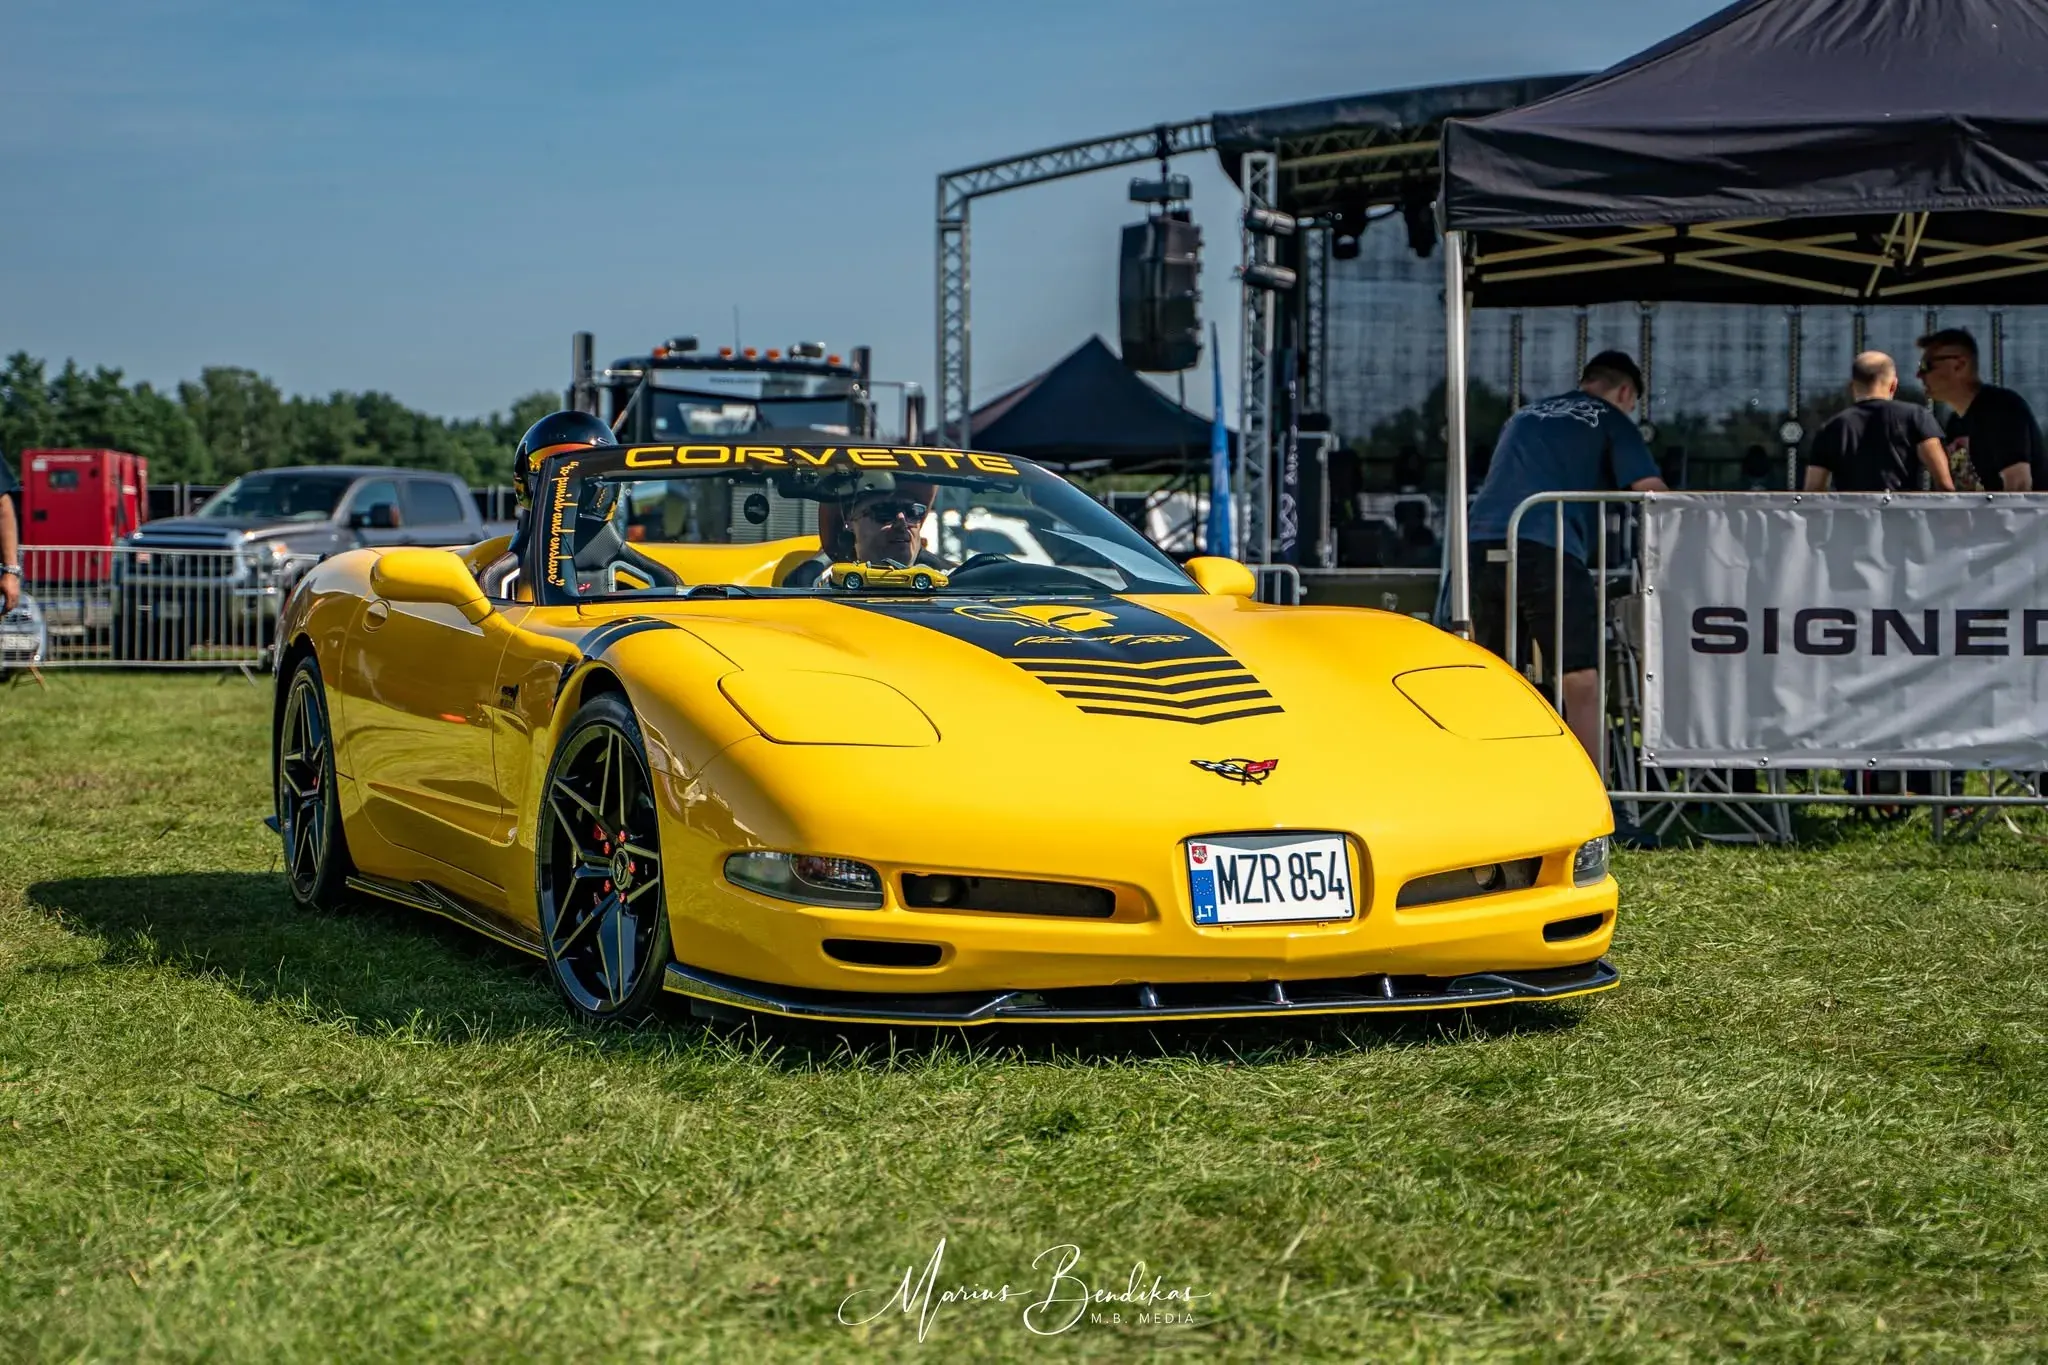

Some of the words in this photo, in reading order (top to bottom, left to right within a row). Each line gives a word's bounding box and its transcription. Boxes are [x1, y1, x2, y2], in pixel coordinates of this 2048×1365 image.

[624, 445, 1020, 476] CORVETTE
[551, 477, 578, 512] punish
[551, 512, 576, 537] and
[1216, 853, 1286, 905] MZR
[1288, 851, 1345, 902] 854
[1197, 903, 1214, 919] LT
